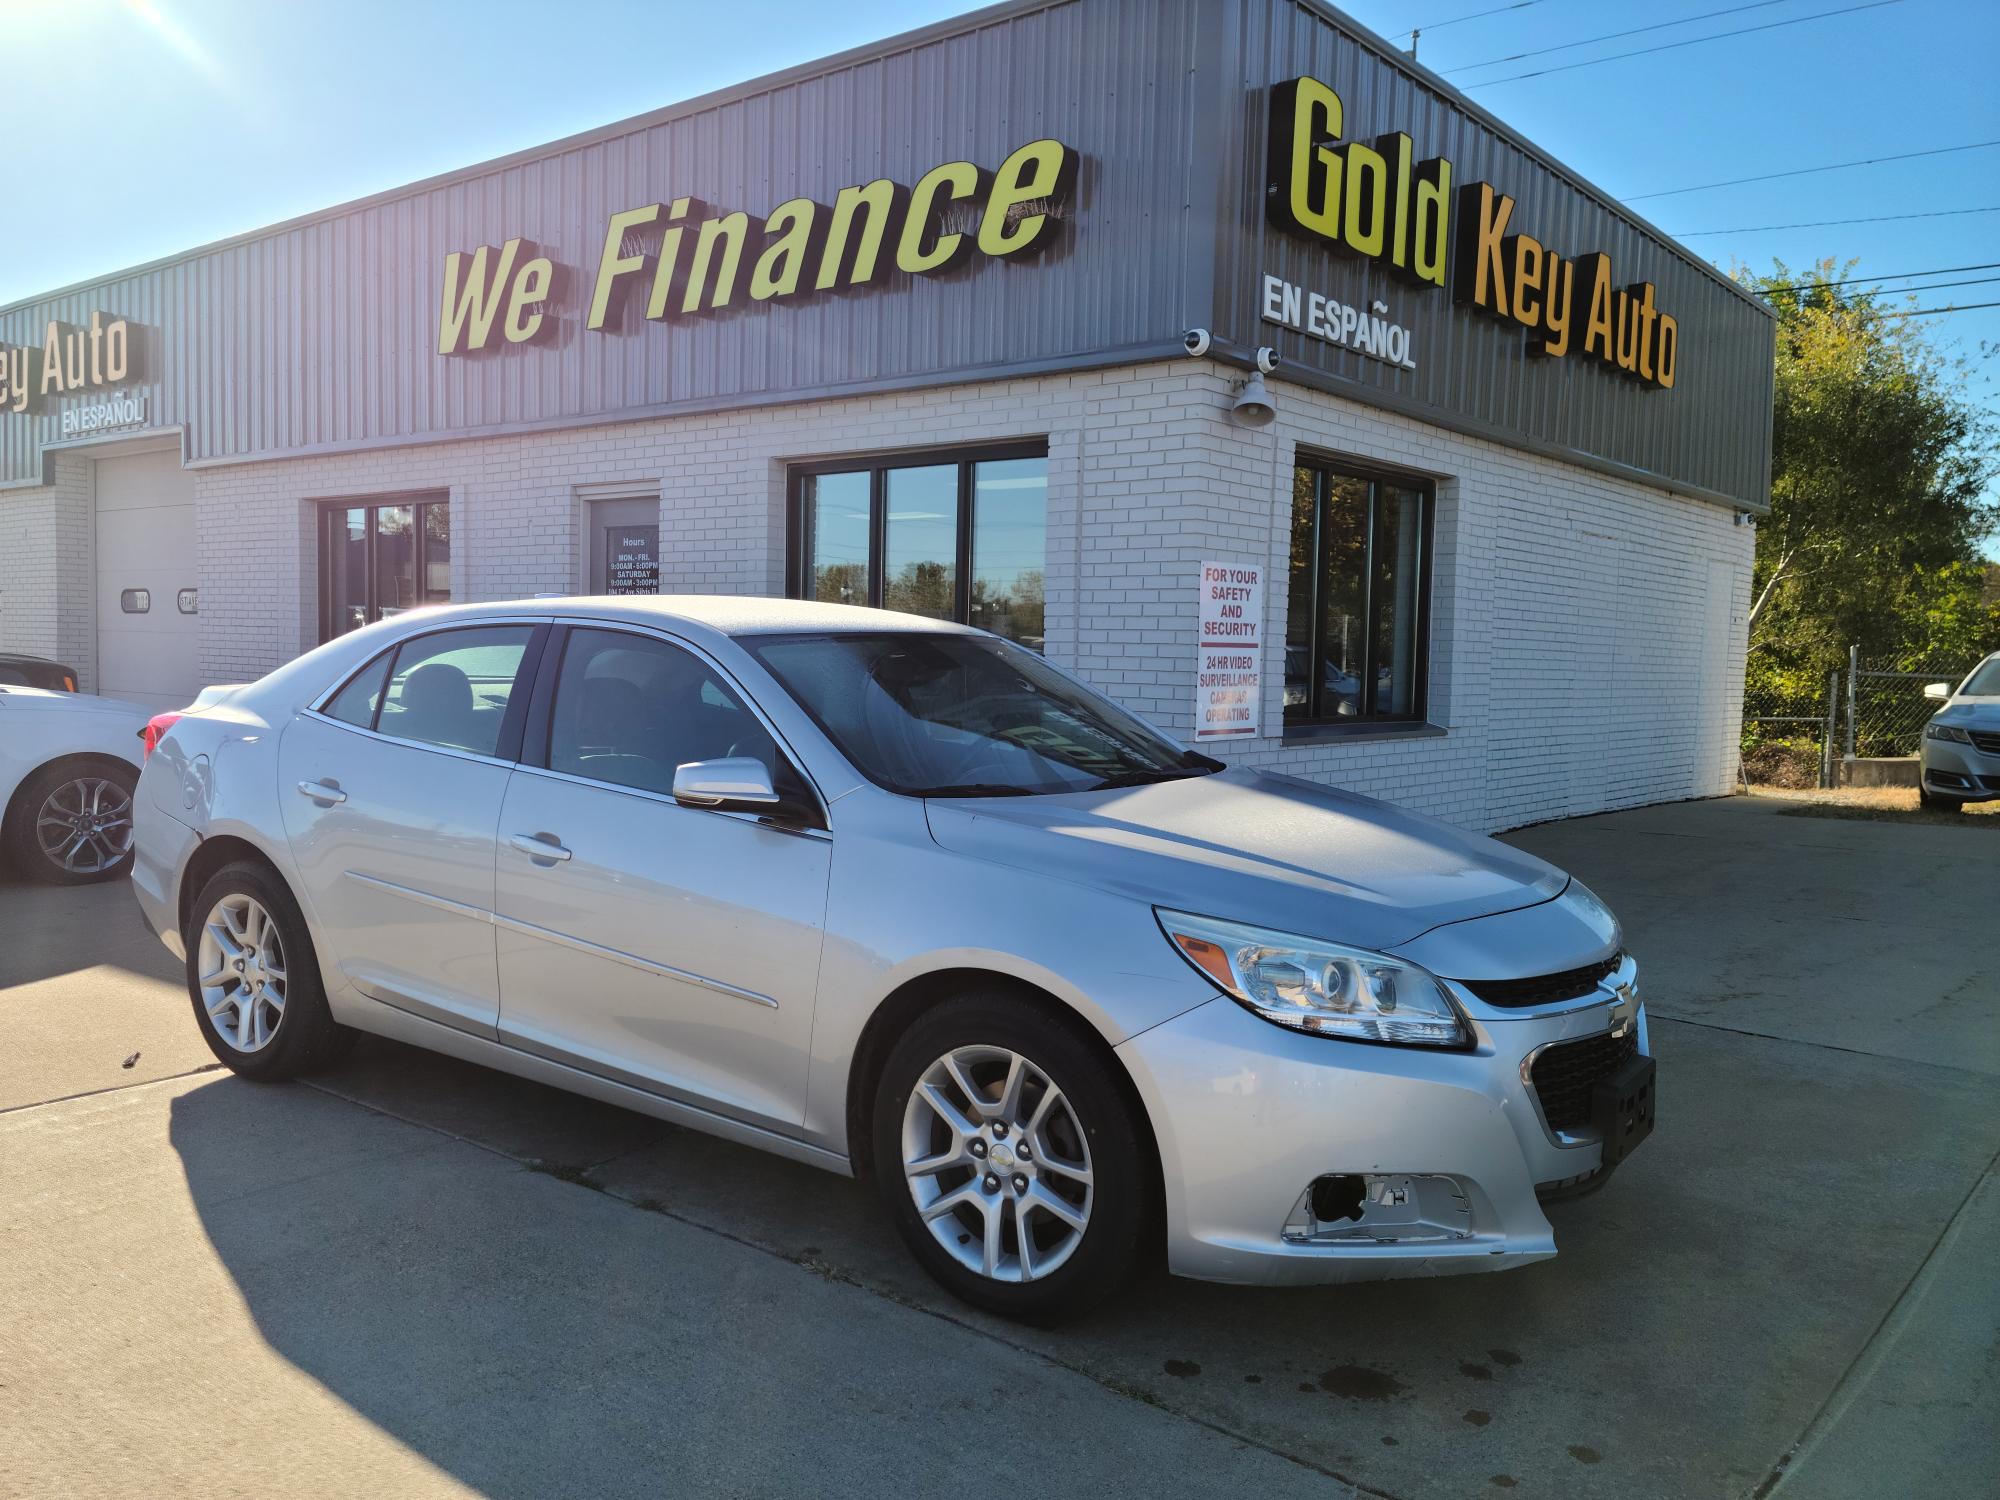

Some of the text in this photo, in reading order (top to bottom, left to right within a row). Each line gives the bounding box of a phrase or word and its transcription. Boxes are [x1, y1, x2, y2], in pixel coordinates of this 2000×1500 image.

[1289, 75, 1679, 390] Gold Key Auto
[437, 138, 1065, 357] We Finance
[1263, 274, 1417, 369] EN ESPAÑOL
[40, 310, 127, 395] Auto
[63, 391, 145, 433] EN ESPAÑOL
[623, 537, 646, 547] Hours
[617, 570, 651, 578] SATURDAY
[1205, 567, 1258, 585] FOR YOUR
[1211, 585, 1252, 602] SAFETY
[1220, 604, 1243, 619] AND
[1204, 621, 1257, 637] SECURITY
[1206, 655, 1253, 670] 24 HR VIDEO
[1199, 673, 1258, 688] SURVEILLANCE
[1205, 707, 1250, 722] OPERATING
